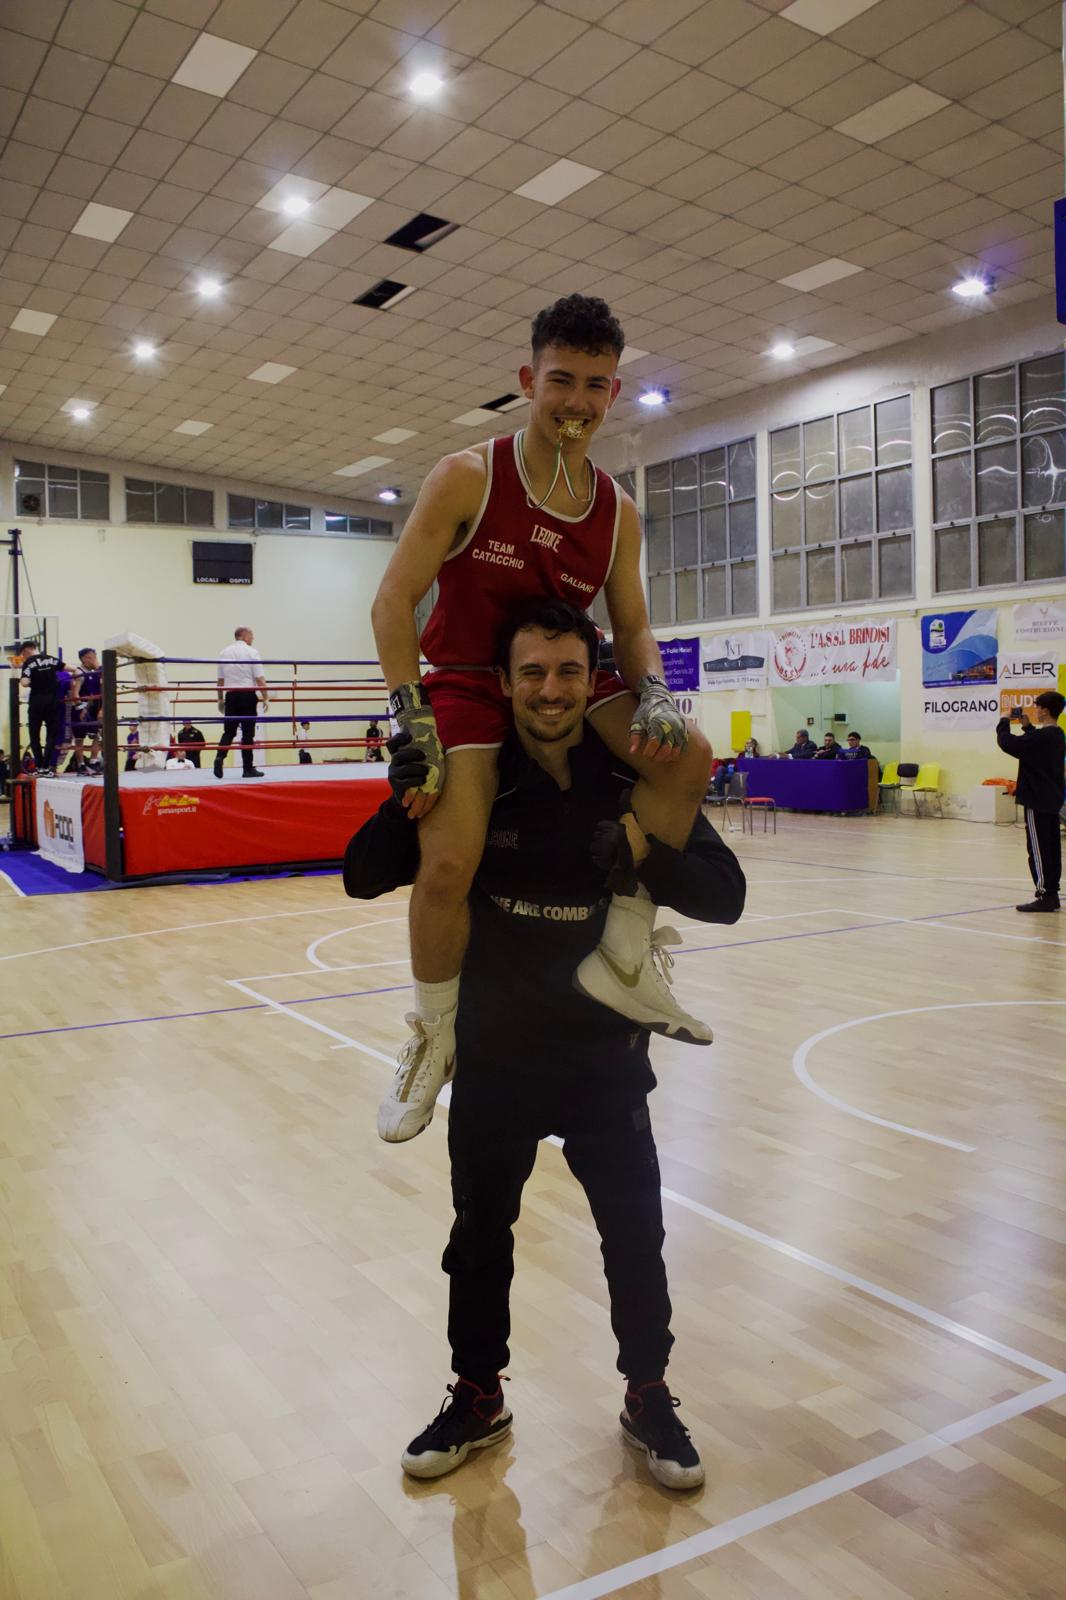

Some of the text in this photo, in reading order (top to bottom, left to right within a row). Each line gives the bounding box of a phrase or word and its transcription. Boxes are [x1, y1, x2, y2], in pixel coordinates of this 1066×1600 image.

[488, 540, 515, 555] TEAM
[530, 524, 563, 553] LEONE
[472, 548, 525, 570] CATACCHIO
[560, 573, 595, 593] GALIANO
[849, 626, 890, 645] BRINDISI
[832, 660, 858, 674] una
[999, 662, 1056, 678] ALFER
[924, 699, 998, 713] FILOGRANO
[512, 899, 541, 918] ARE
